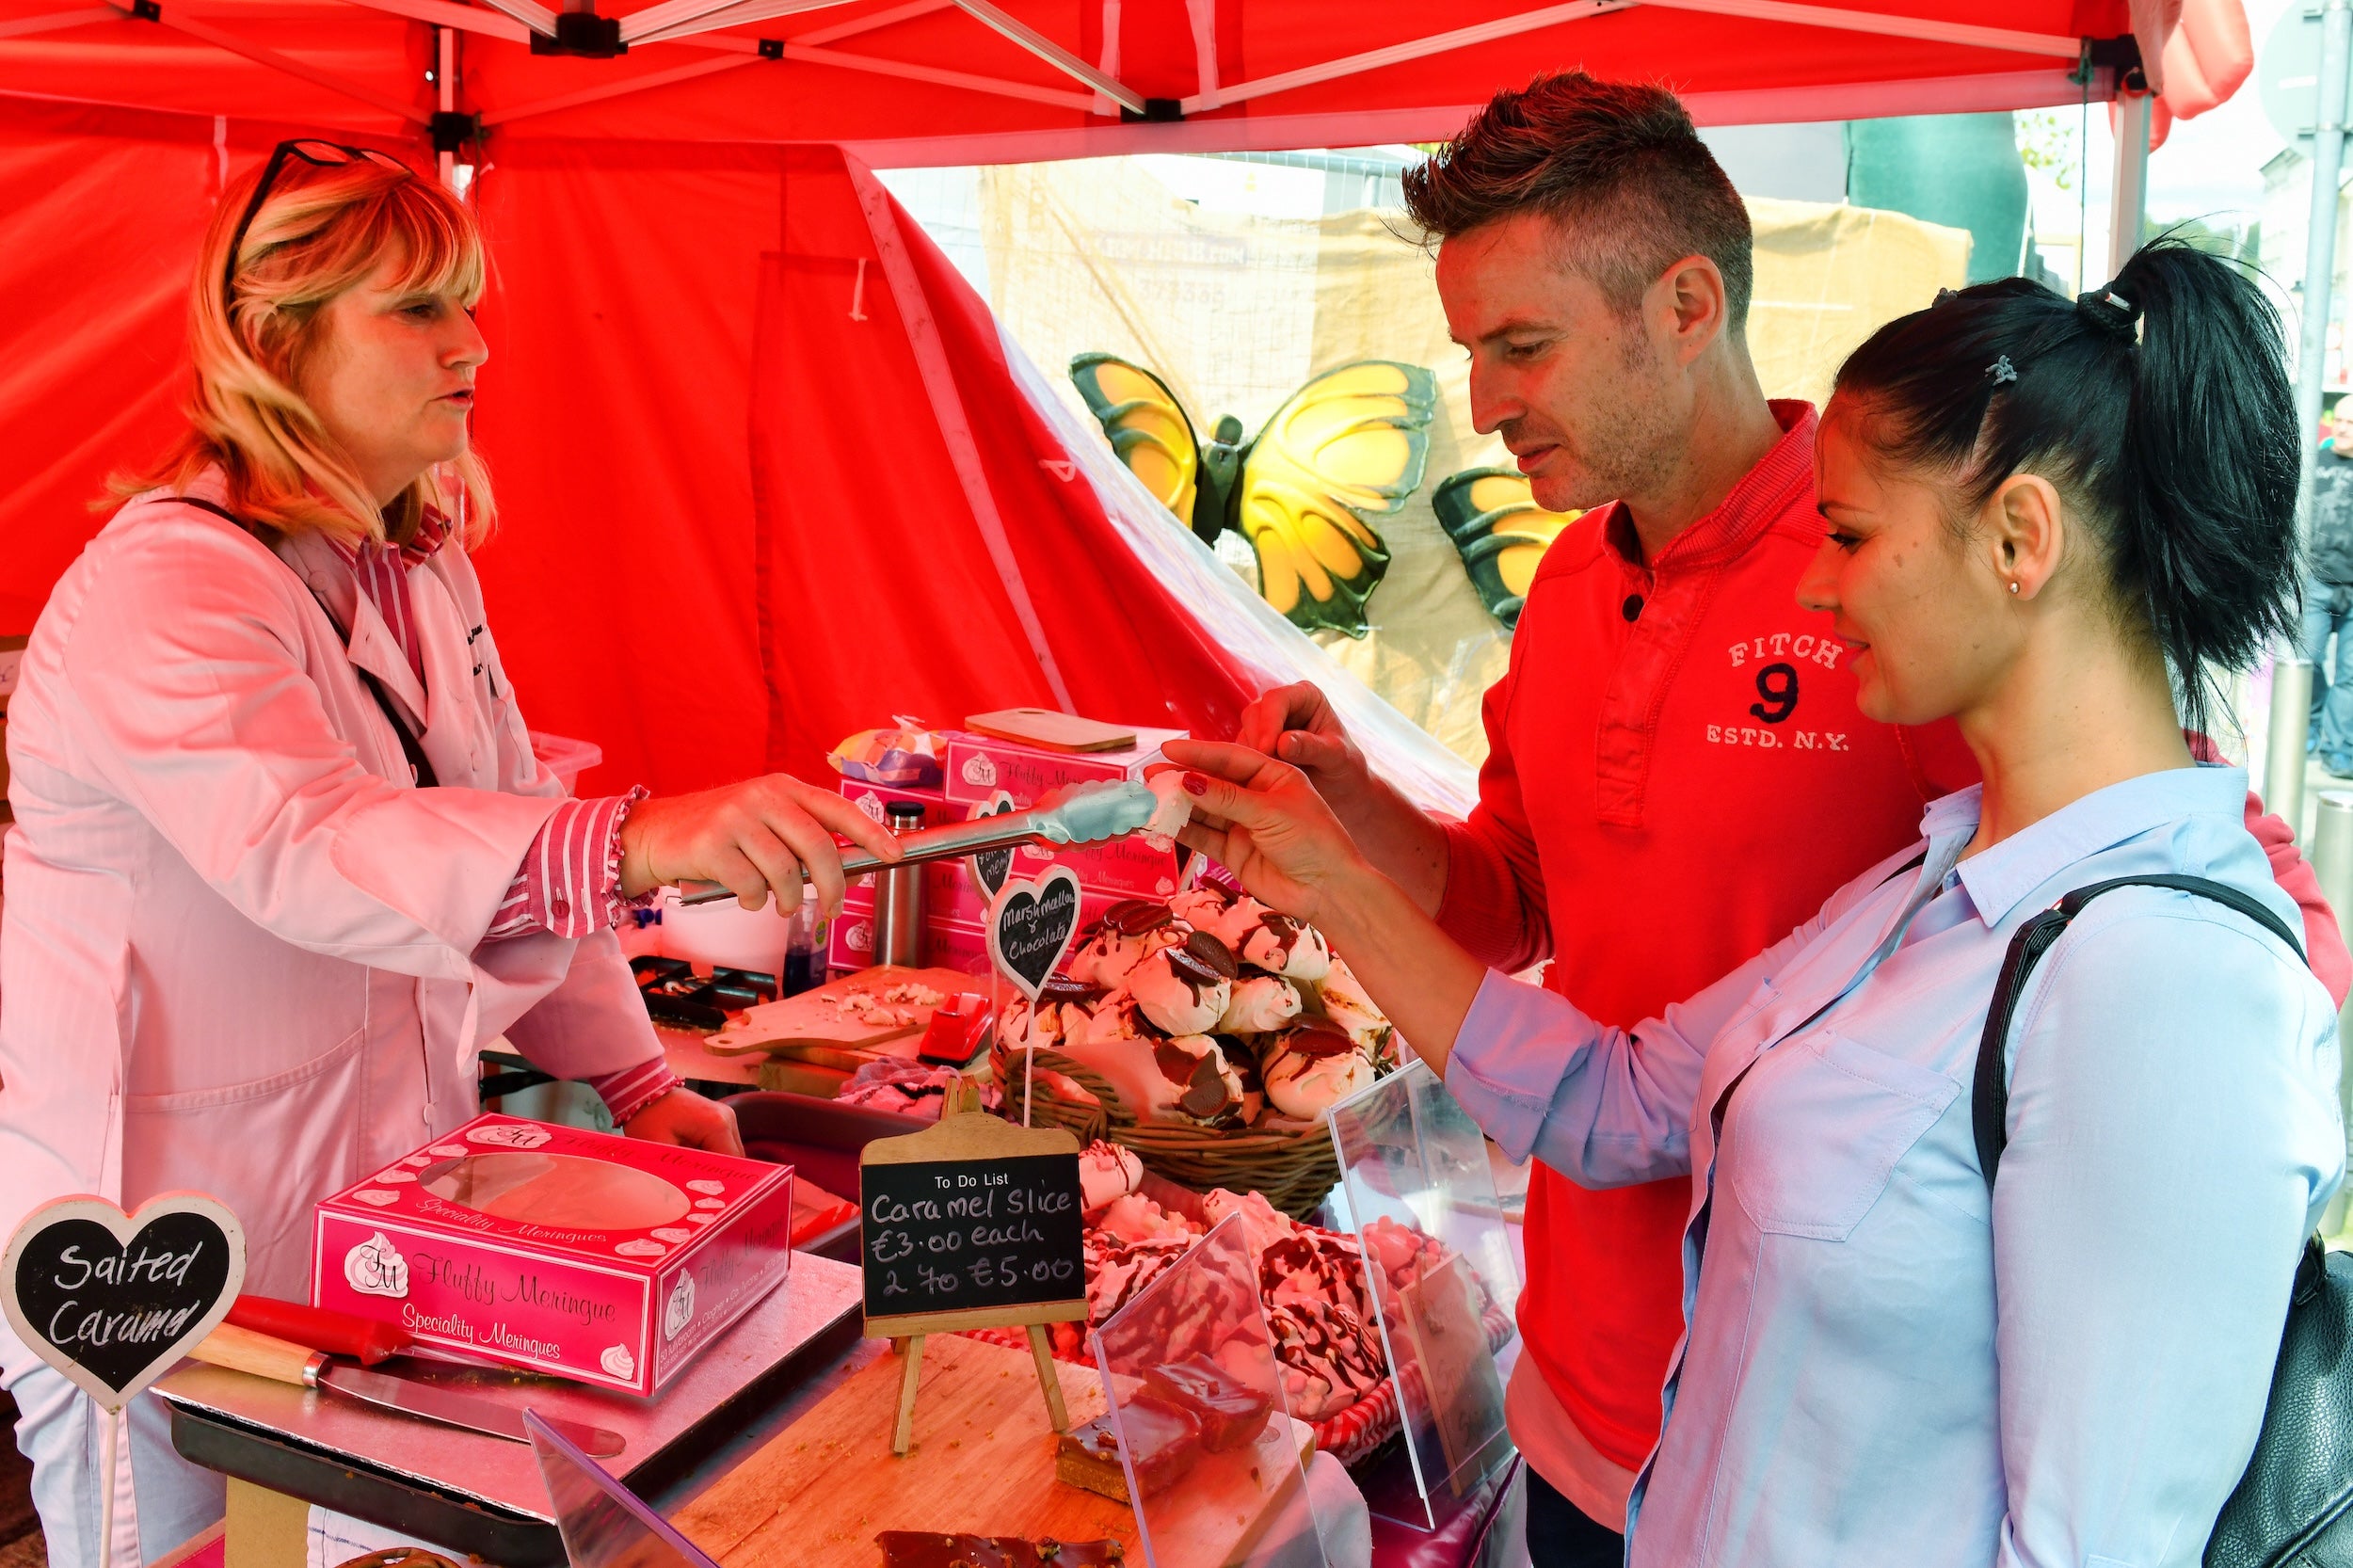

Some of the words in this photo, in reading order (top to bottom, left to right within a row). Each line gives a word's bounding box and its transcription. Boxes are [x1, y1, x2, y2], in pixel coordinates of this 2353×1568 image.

[1728, 632, 1843, 669] FITCH
[1750, 663, 1799, 724] 9
[1706, 724, 1784, 749] ESTD.
[1794, 730, 1849, 751] N.Y.
[1009, 921, 1067, 960] Chocolate
[871, 1188, 995, 1224] Caramel
[1007, 1178, 1072, 1215] Slice
[935, 1176, 951, 1190] To
[958, 1175, 977, 1189] Do
[984, 1173, 1009, 1187] List
[416, 1198, 495, 1231] Speciality
[497, 1224, 608, 1243] Meringues
[871, 1229, 963, 1263] €3.00
[970, 1219, 1045, 1248] each
[412, 1253, 496, 1306] Fluffy
[501, 1273, 617, 1327] Meringue
[883, 1270, 908, 1296] 2
[967, 1255, 1075, 1288] €5.00
[402, 1303, 474, 1347] Speciality
[478, 1321, 562, 1360] Meringues
